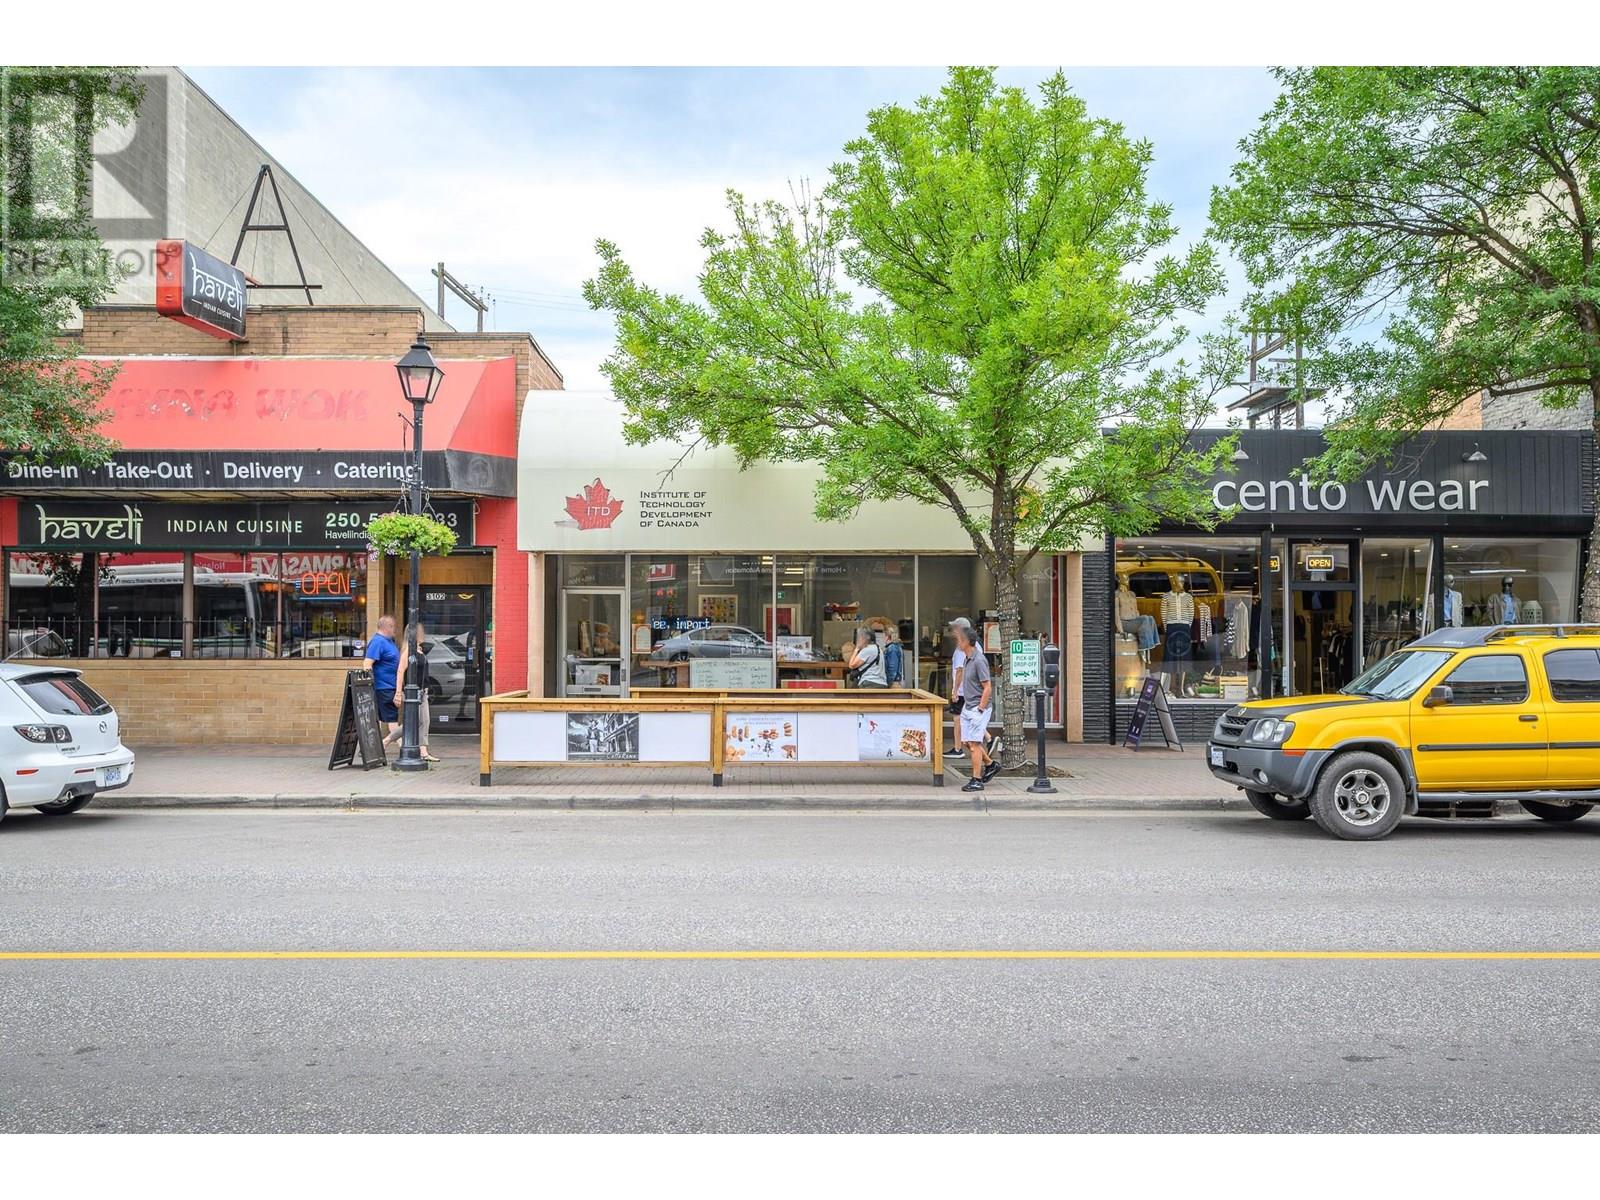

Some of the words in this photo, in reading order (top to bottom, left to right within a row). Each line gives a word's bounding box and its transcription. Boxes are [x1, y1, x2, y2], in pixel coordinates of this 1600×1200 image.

[104, 462, 194, 479] Take-Out
[223, 462, 304, 483] Delivery
[640, 491, 690, 499] INSTITUTE
[1212, 473, 1348, 512] cento
[1366, 479, 1489, 512] wear
[587, 505, 611, 517] ITD
[640, 501, 706, 509] TECHNOLOGY
[640, 511, 713, 519] DEVELOPMENT
[35, 504, 144, 545] haveli
[167, 519, 229, 534] INDIAN
[236, 519, 303, 534] CUISINE
[657, 520, 700, 528] CANADA
[1308, 558, 1332, 569] OPEN
[302, 572, 350, 595] OPEN
[676, 617, 711, 630] import
[1013, 642, 1022, 652] 10
